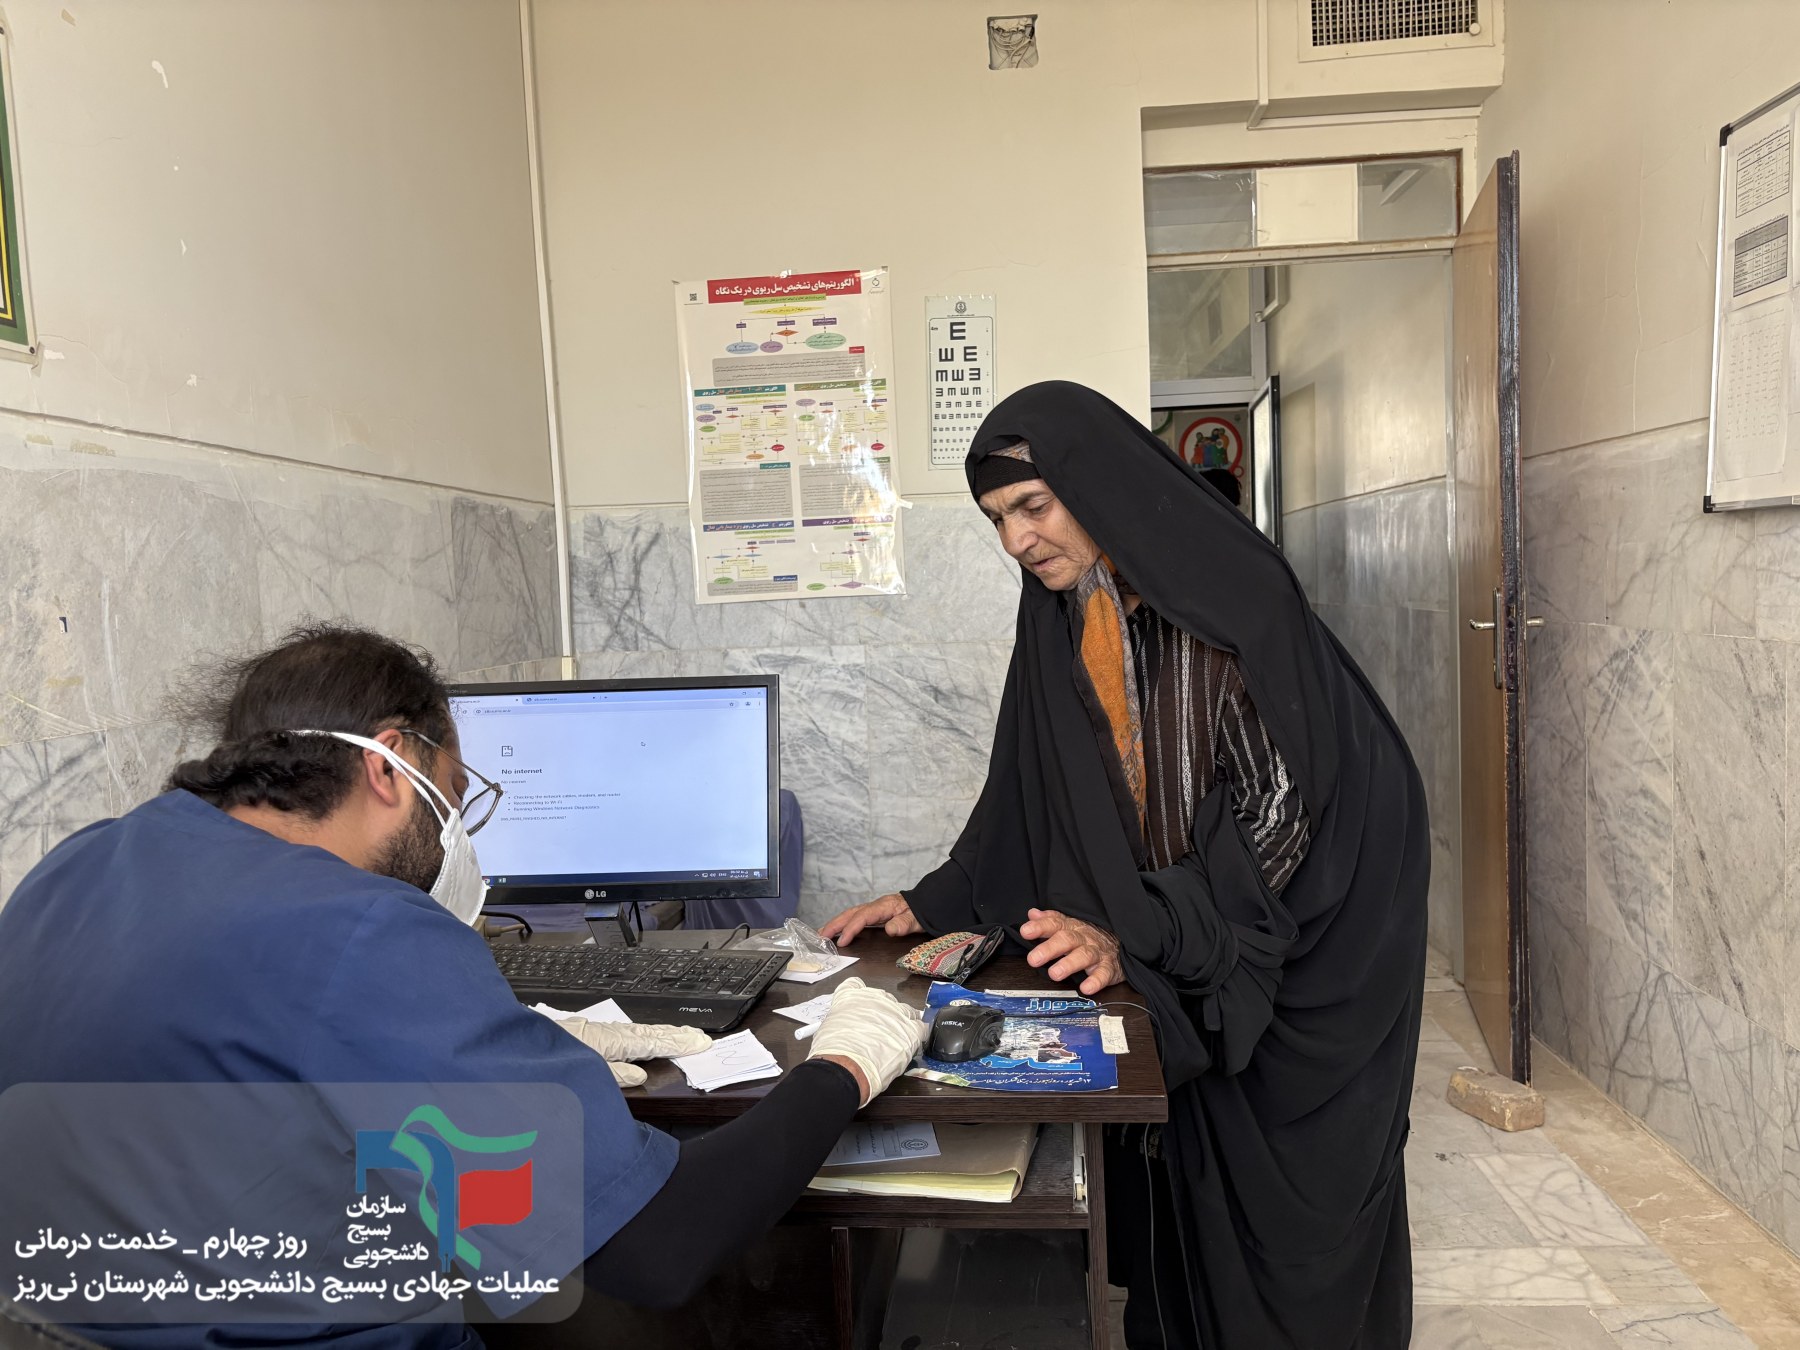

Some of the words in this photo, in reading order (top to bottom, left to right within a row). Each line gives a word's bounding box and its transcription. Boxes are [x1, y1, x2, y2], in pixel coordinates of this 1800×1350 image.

[715, 286, 730, 296] نگاه
[743, 286, 752, 296] در
[782, 281, 811, 294] تشخیص
